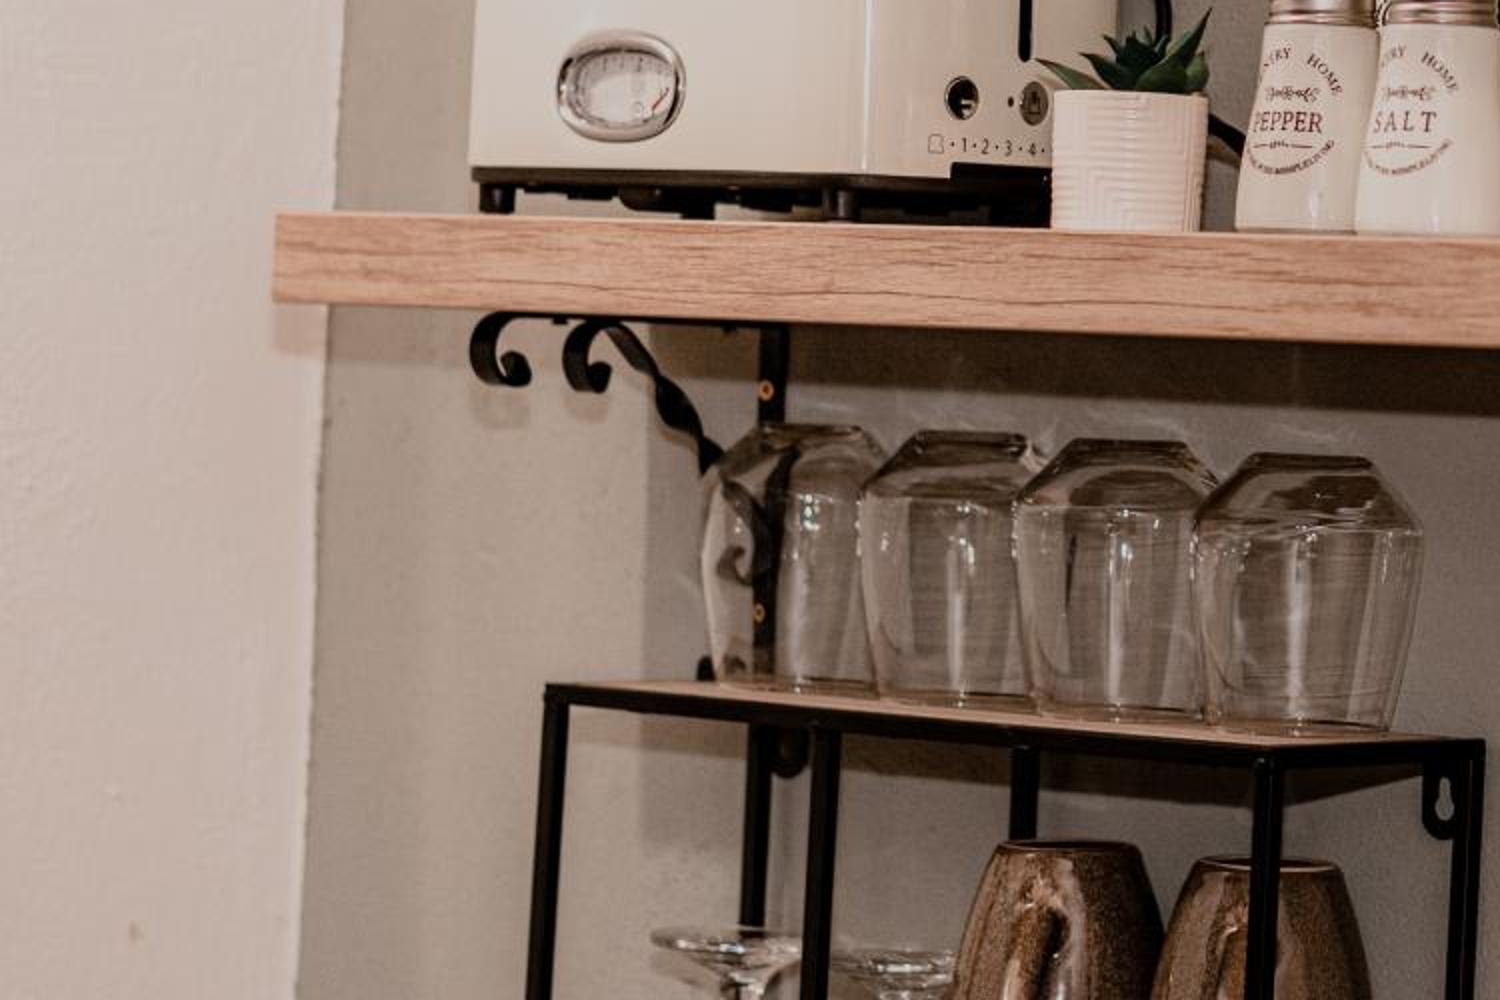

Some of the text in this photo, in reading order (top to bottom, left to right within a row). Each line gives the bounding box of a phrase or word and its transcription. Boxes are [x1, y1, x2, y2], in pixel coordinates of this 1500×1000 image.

[1307, 53, 1343, 96] HOME
[1420, 51, 1460, 94] HOME
[1252, 110, 1323, 135] PEPPER
[1374, 110, 1438, 133] SALT
